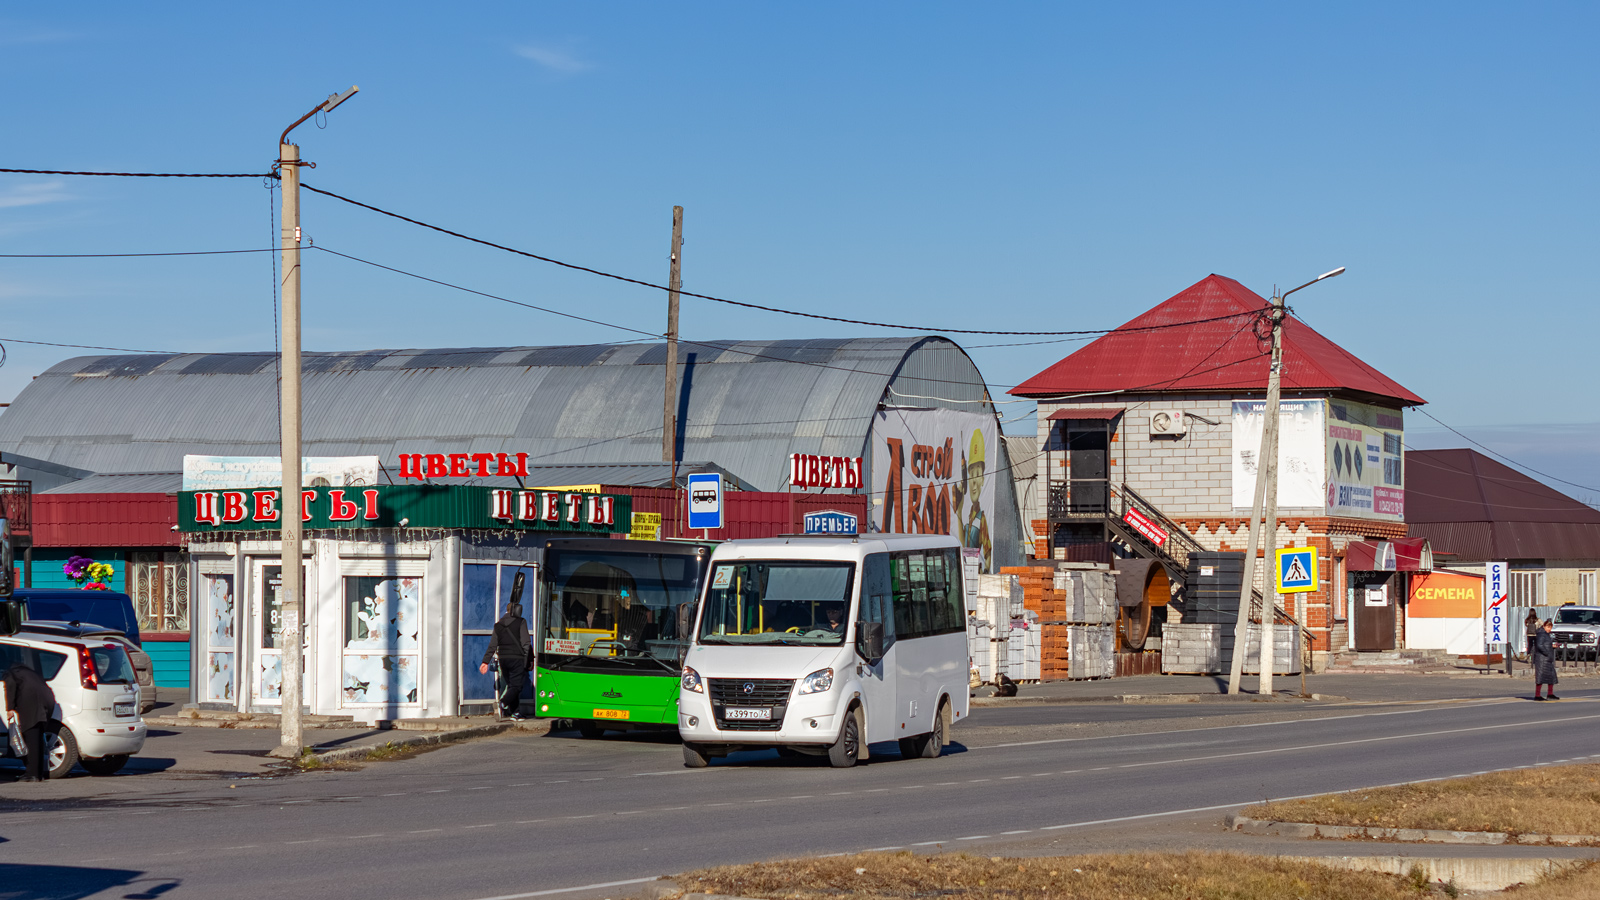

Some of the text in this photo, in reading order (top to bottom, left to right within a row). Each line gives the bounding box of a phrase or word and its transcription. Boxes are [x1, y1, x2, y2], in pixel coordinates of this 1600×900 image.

[1253, 403, 1304, 412] НАСЯЩИЕ
[398, 452, 531, 481] ЦВЕТЫ
[789, 453, 864, 490] ЦВЕТЫ
[911, 436, 953, 480] СТРОЙ
[491, 489, 615, 525] ЦВЕТЫ
[806, 516, 857, 532] ПРЕМЬЕР
[1415, 587, 1475, 600] СЕМЕНА
[1492, 564, 1501, 599] СИЛА
[1492, 607, 1501, 642] ТОКА
